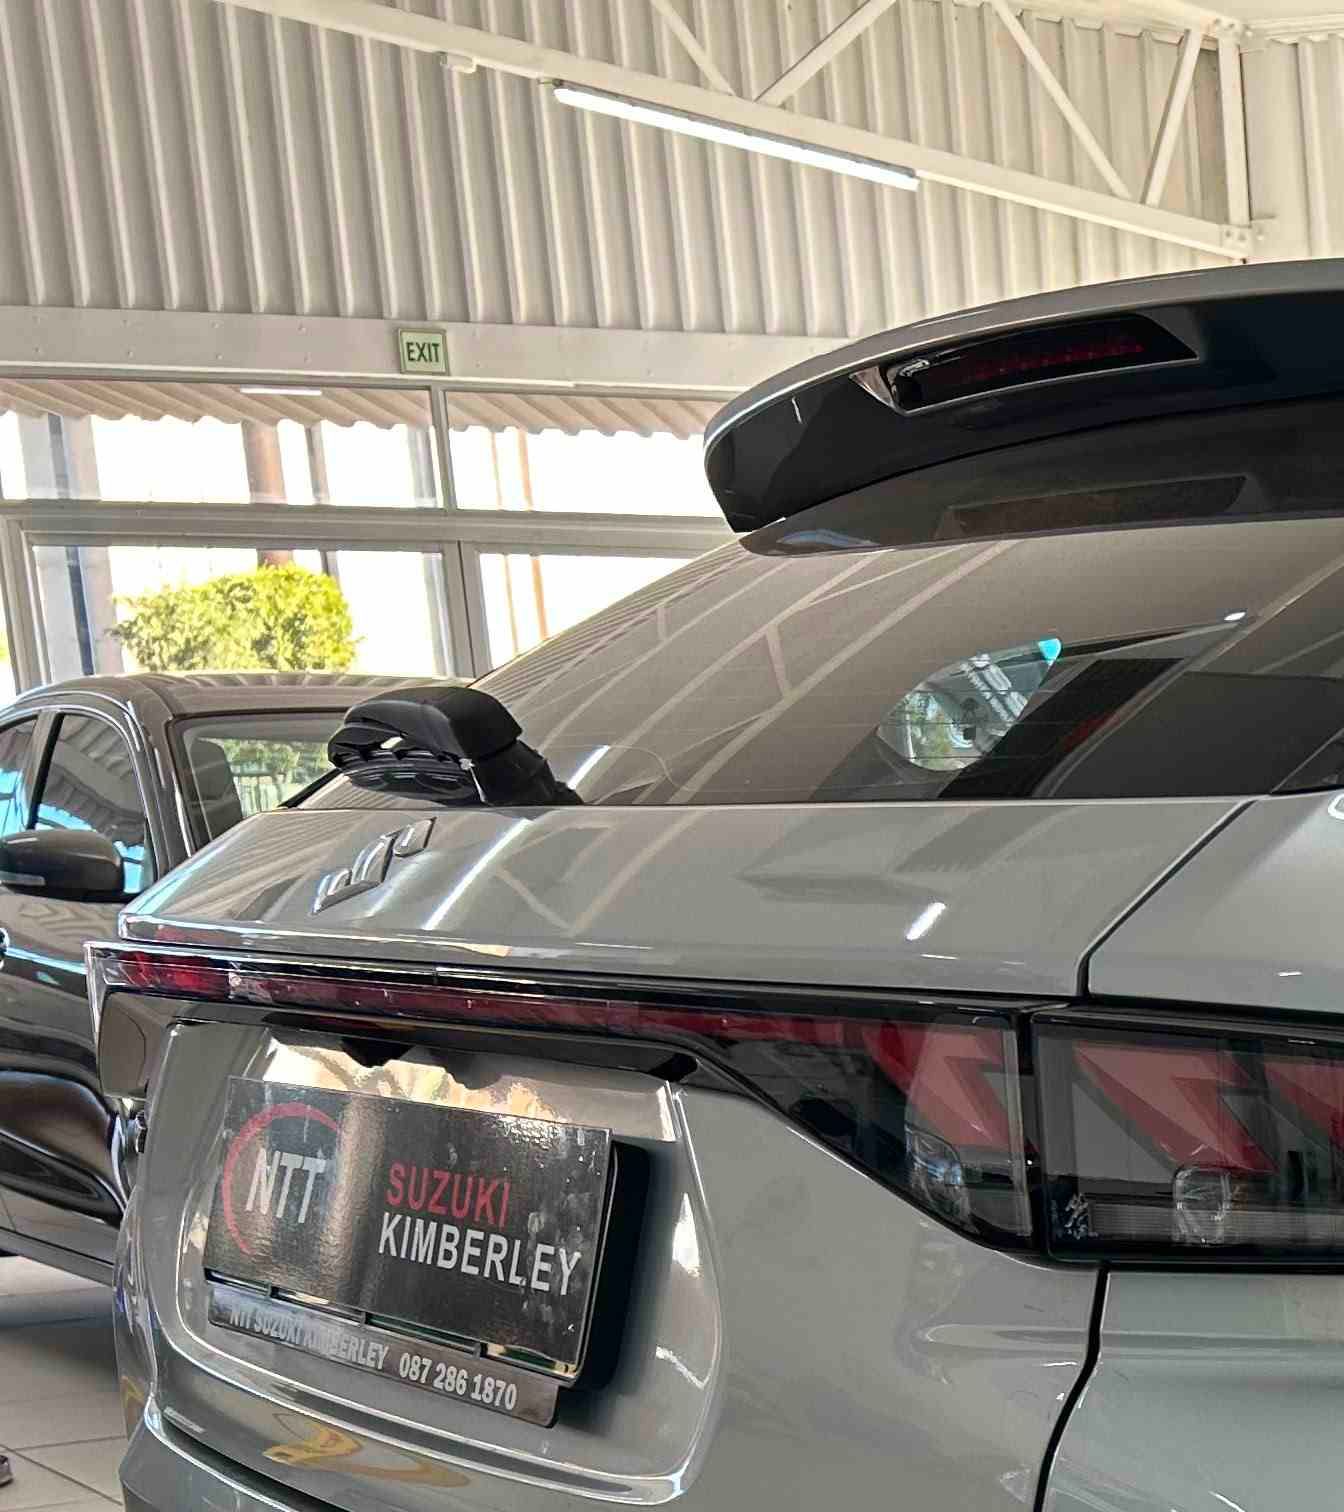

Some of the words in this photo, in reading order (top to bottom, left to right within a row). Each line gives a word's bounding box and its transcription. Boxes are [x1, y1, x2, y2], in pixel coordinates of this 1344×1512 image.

[406, 341, 440, 363] EXIT
[245, 1147, 326, 1224] NTT
[384, 1160, 511, 1229] SUZUKI
[377, 1211, 582, 1296] KIMBERLEY
[253, 1312, 302, 1345] SUZUKI
[302, 1321, 389, 1371] KIMBERLEY
[399, 1352, 431, 1385] 087
[432, 1362, 467, 1398] 286
[470, 1373, 518, 1411] 1870
